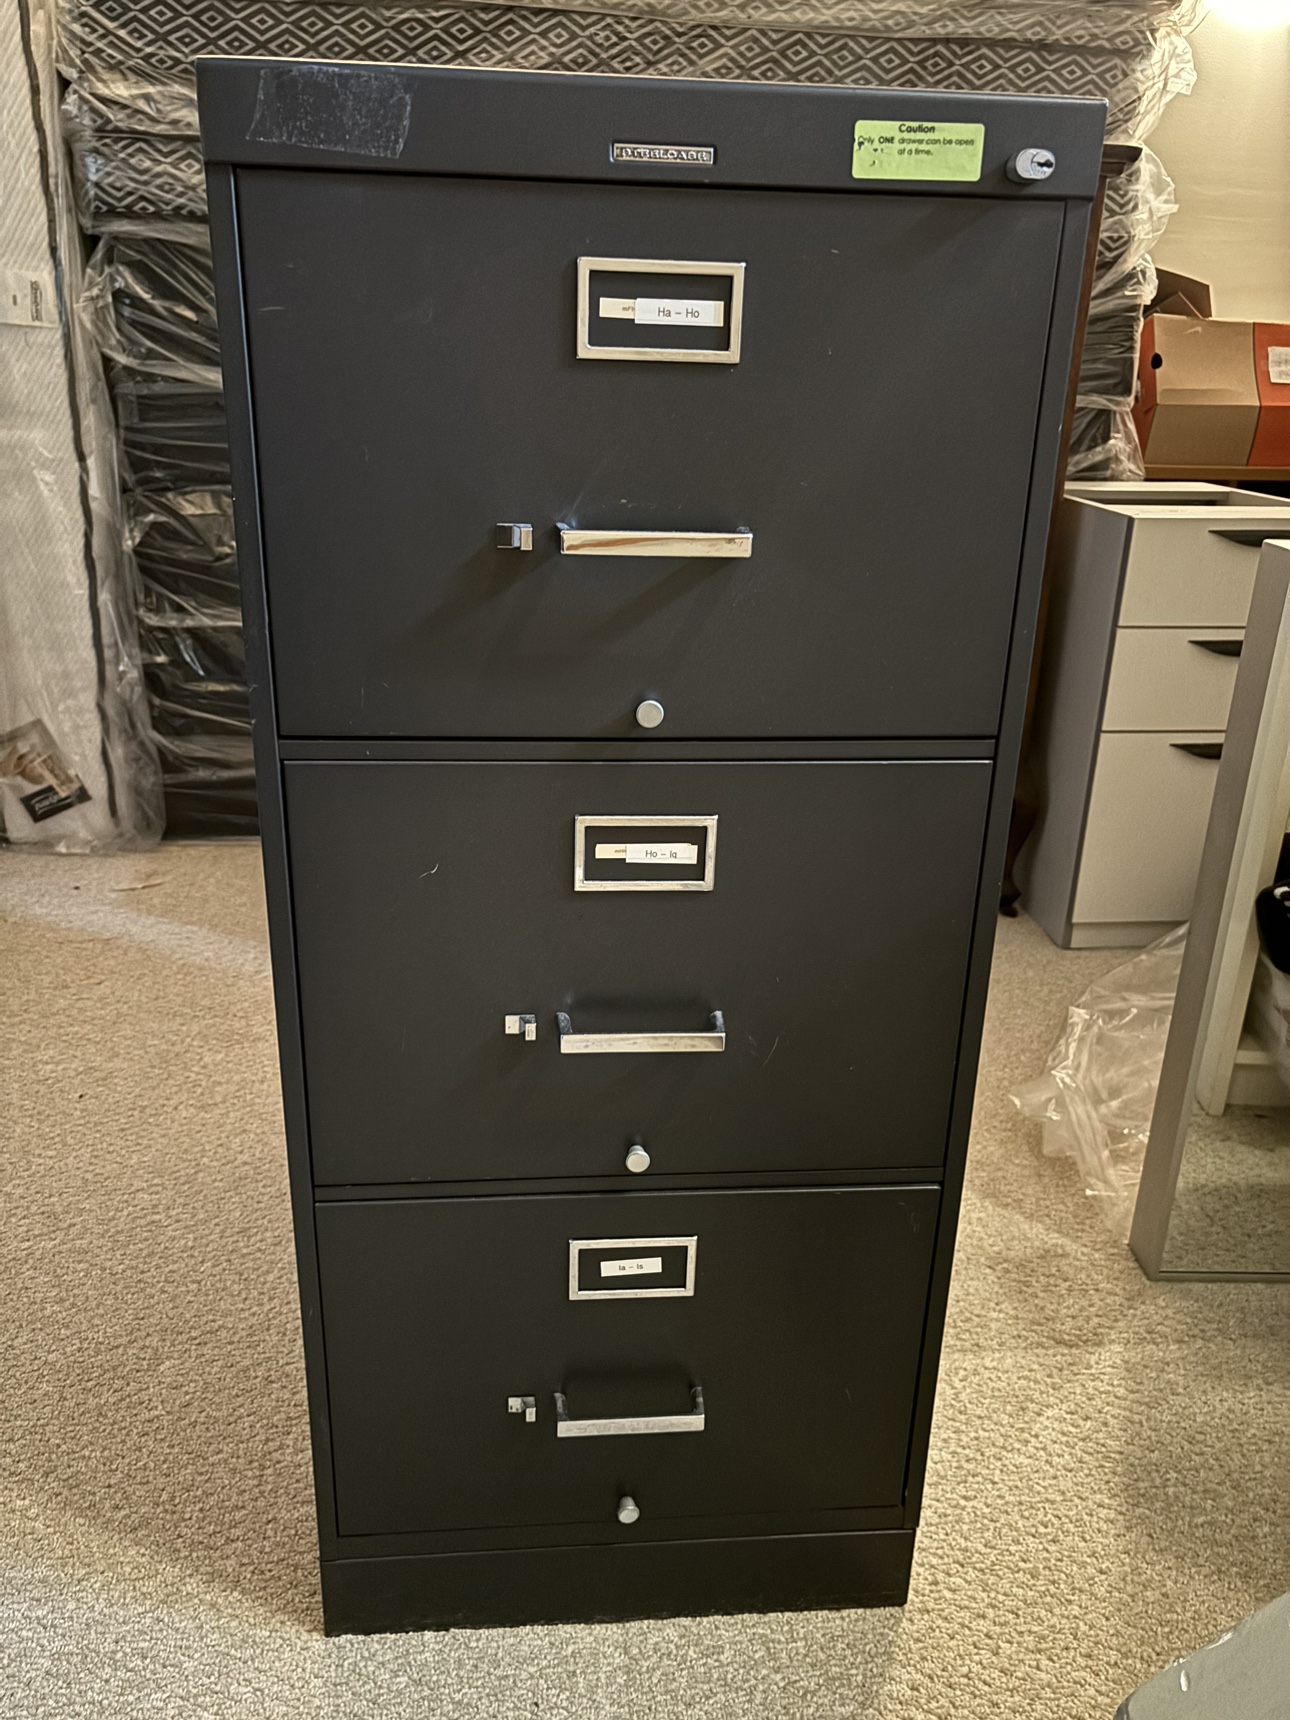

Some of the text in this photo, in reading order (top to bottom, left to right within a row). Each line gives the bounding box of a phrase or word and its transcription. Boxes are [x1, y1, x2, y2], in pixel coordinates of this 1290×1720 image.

[898, 123, 936, 134] Caution
[878, 136, 895, 144] ONE
[898, 136, 925, 145] drawer
[943, 136, 953, 146] be
[954, 138, 975, 147] open
[897, 147, 906, 156] at
[914, 147, 933, 156] time.
[657, 307, 672, 318] Ha
[685, 308, 700, 318] Ho
[645, 850, 658, 858] Ho
